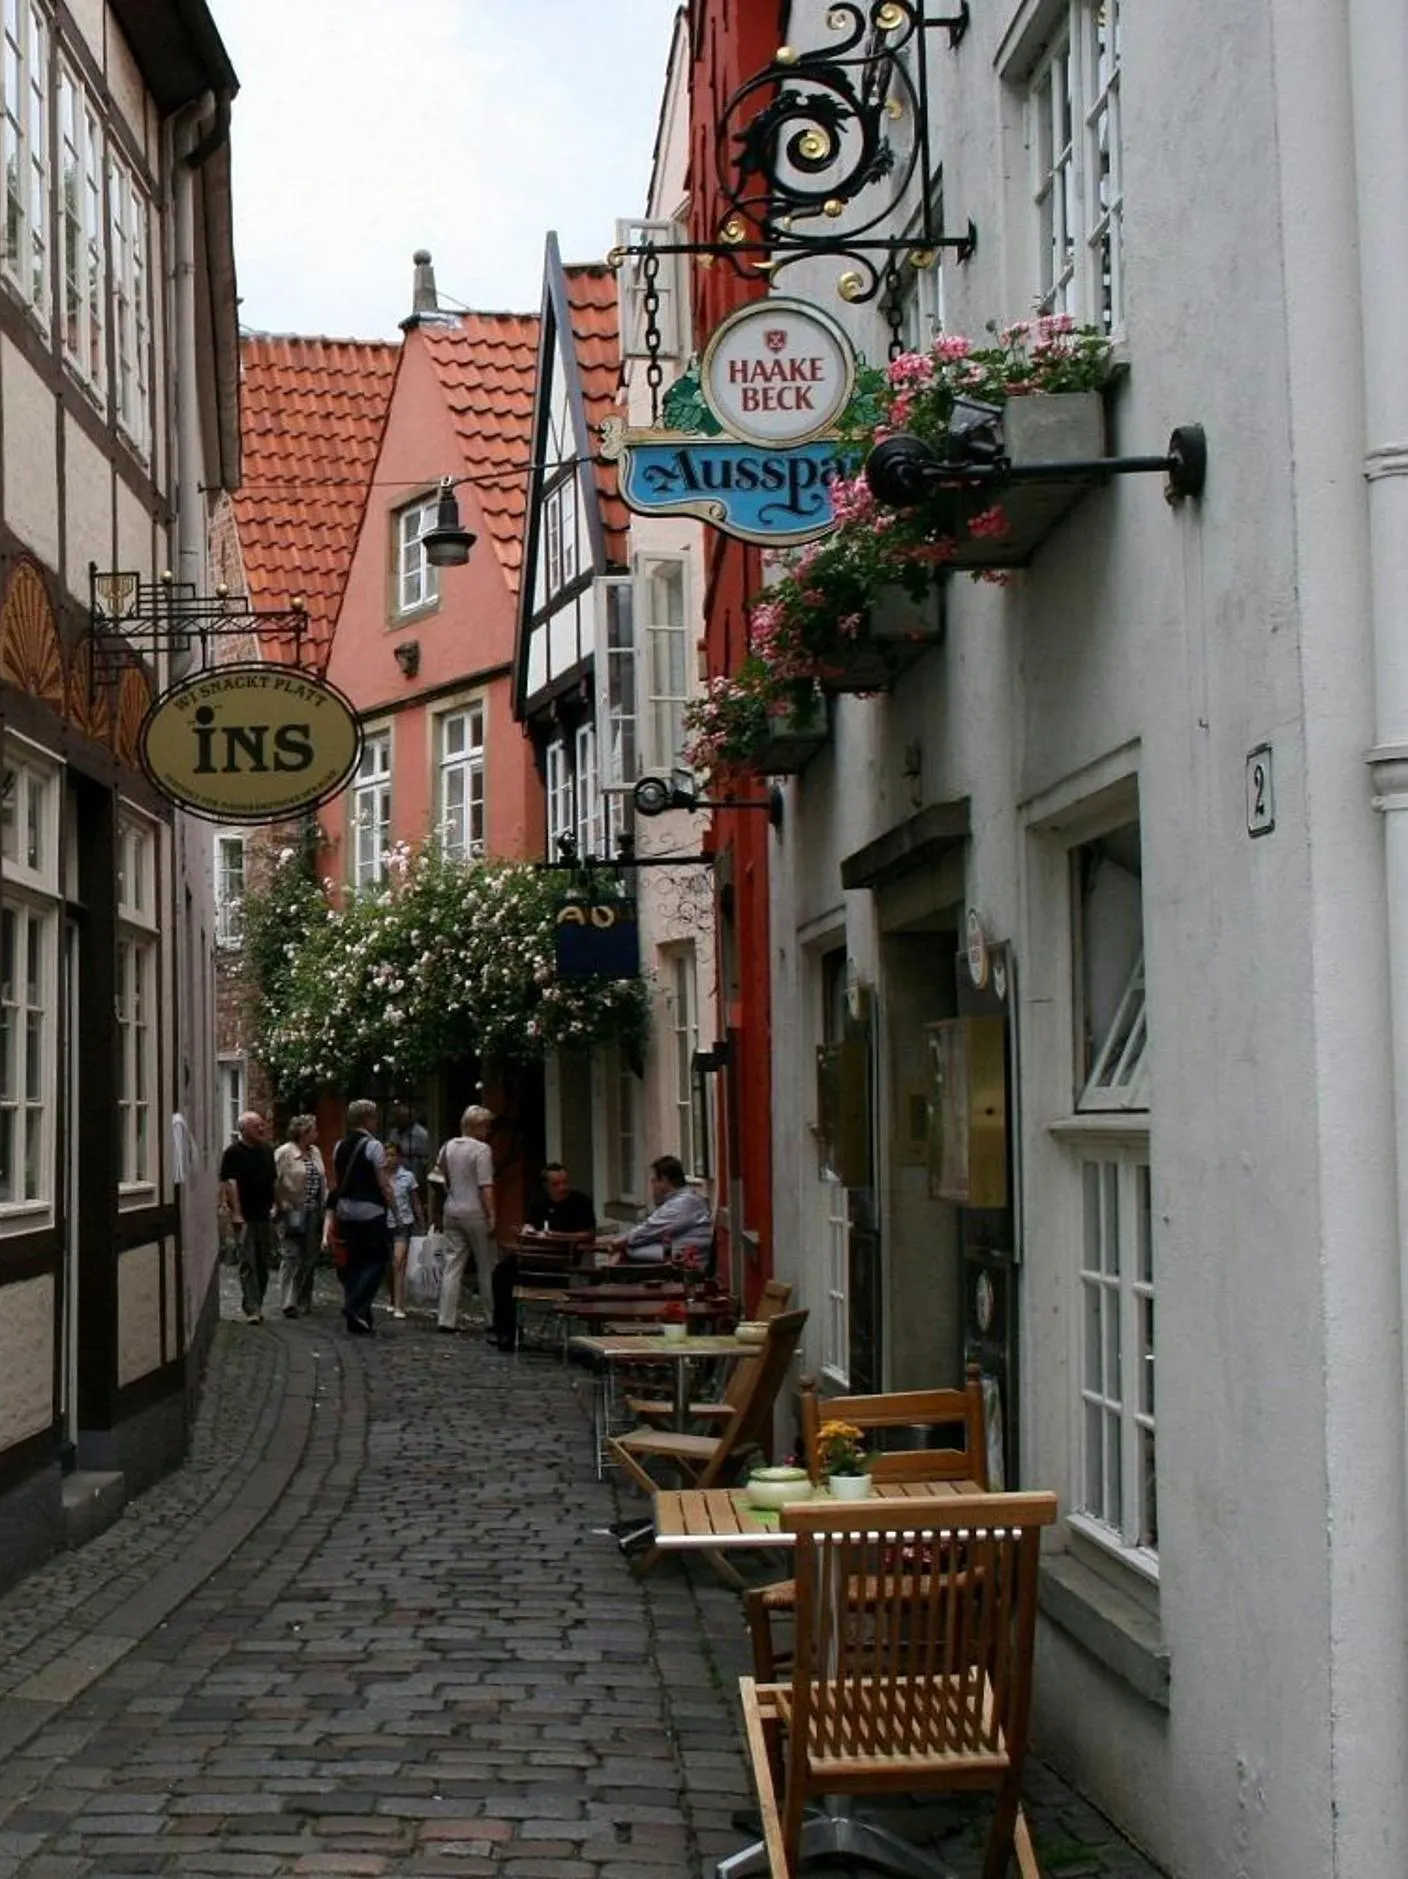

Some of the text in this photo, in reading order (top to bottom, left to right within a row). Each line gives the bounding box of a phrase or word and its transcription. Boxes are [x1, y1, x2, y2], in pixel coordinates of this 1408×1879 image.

[728, 357, 826, 384] HAAKE
[741, 385, 815, 412] BECK
[200, 675, 271, 698] SNACKT
[273, 677, 328, 708] PLATT
[1253, 764, 1265, 819] 2
